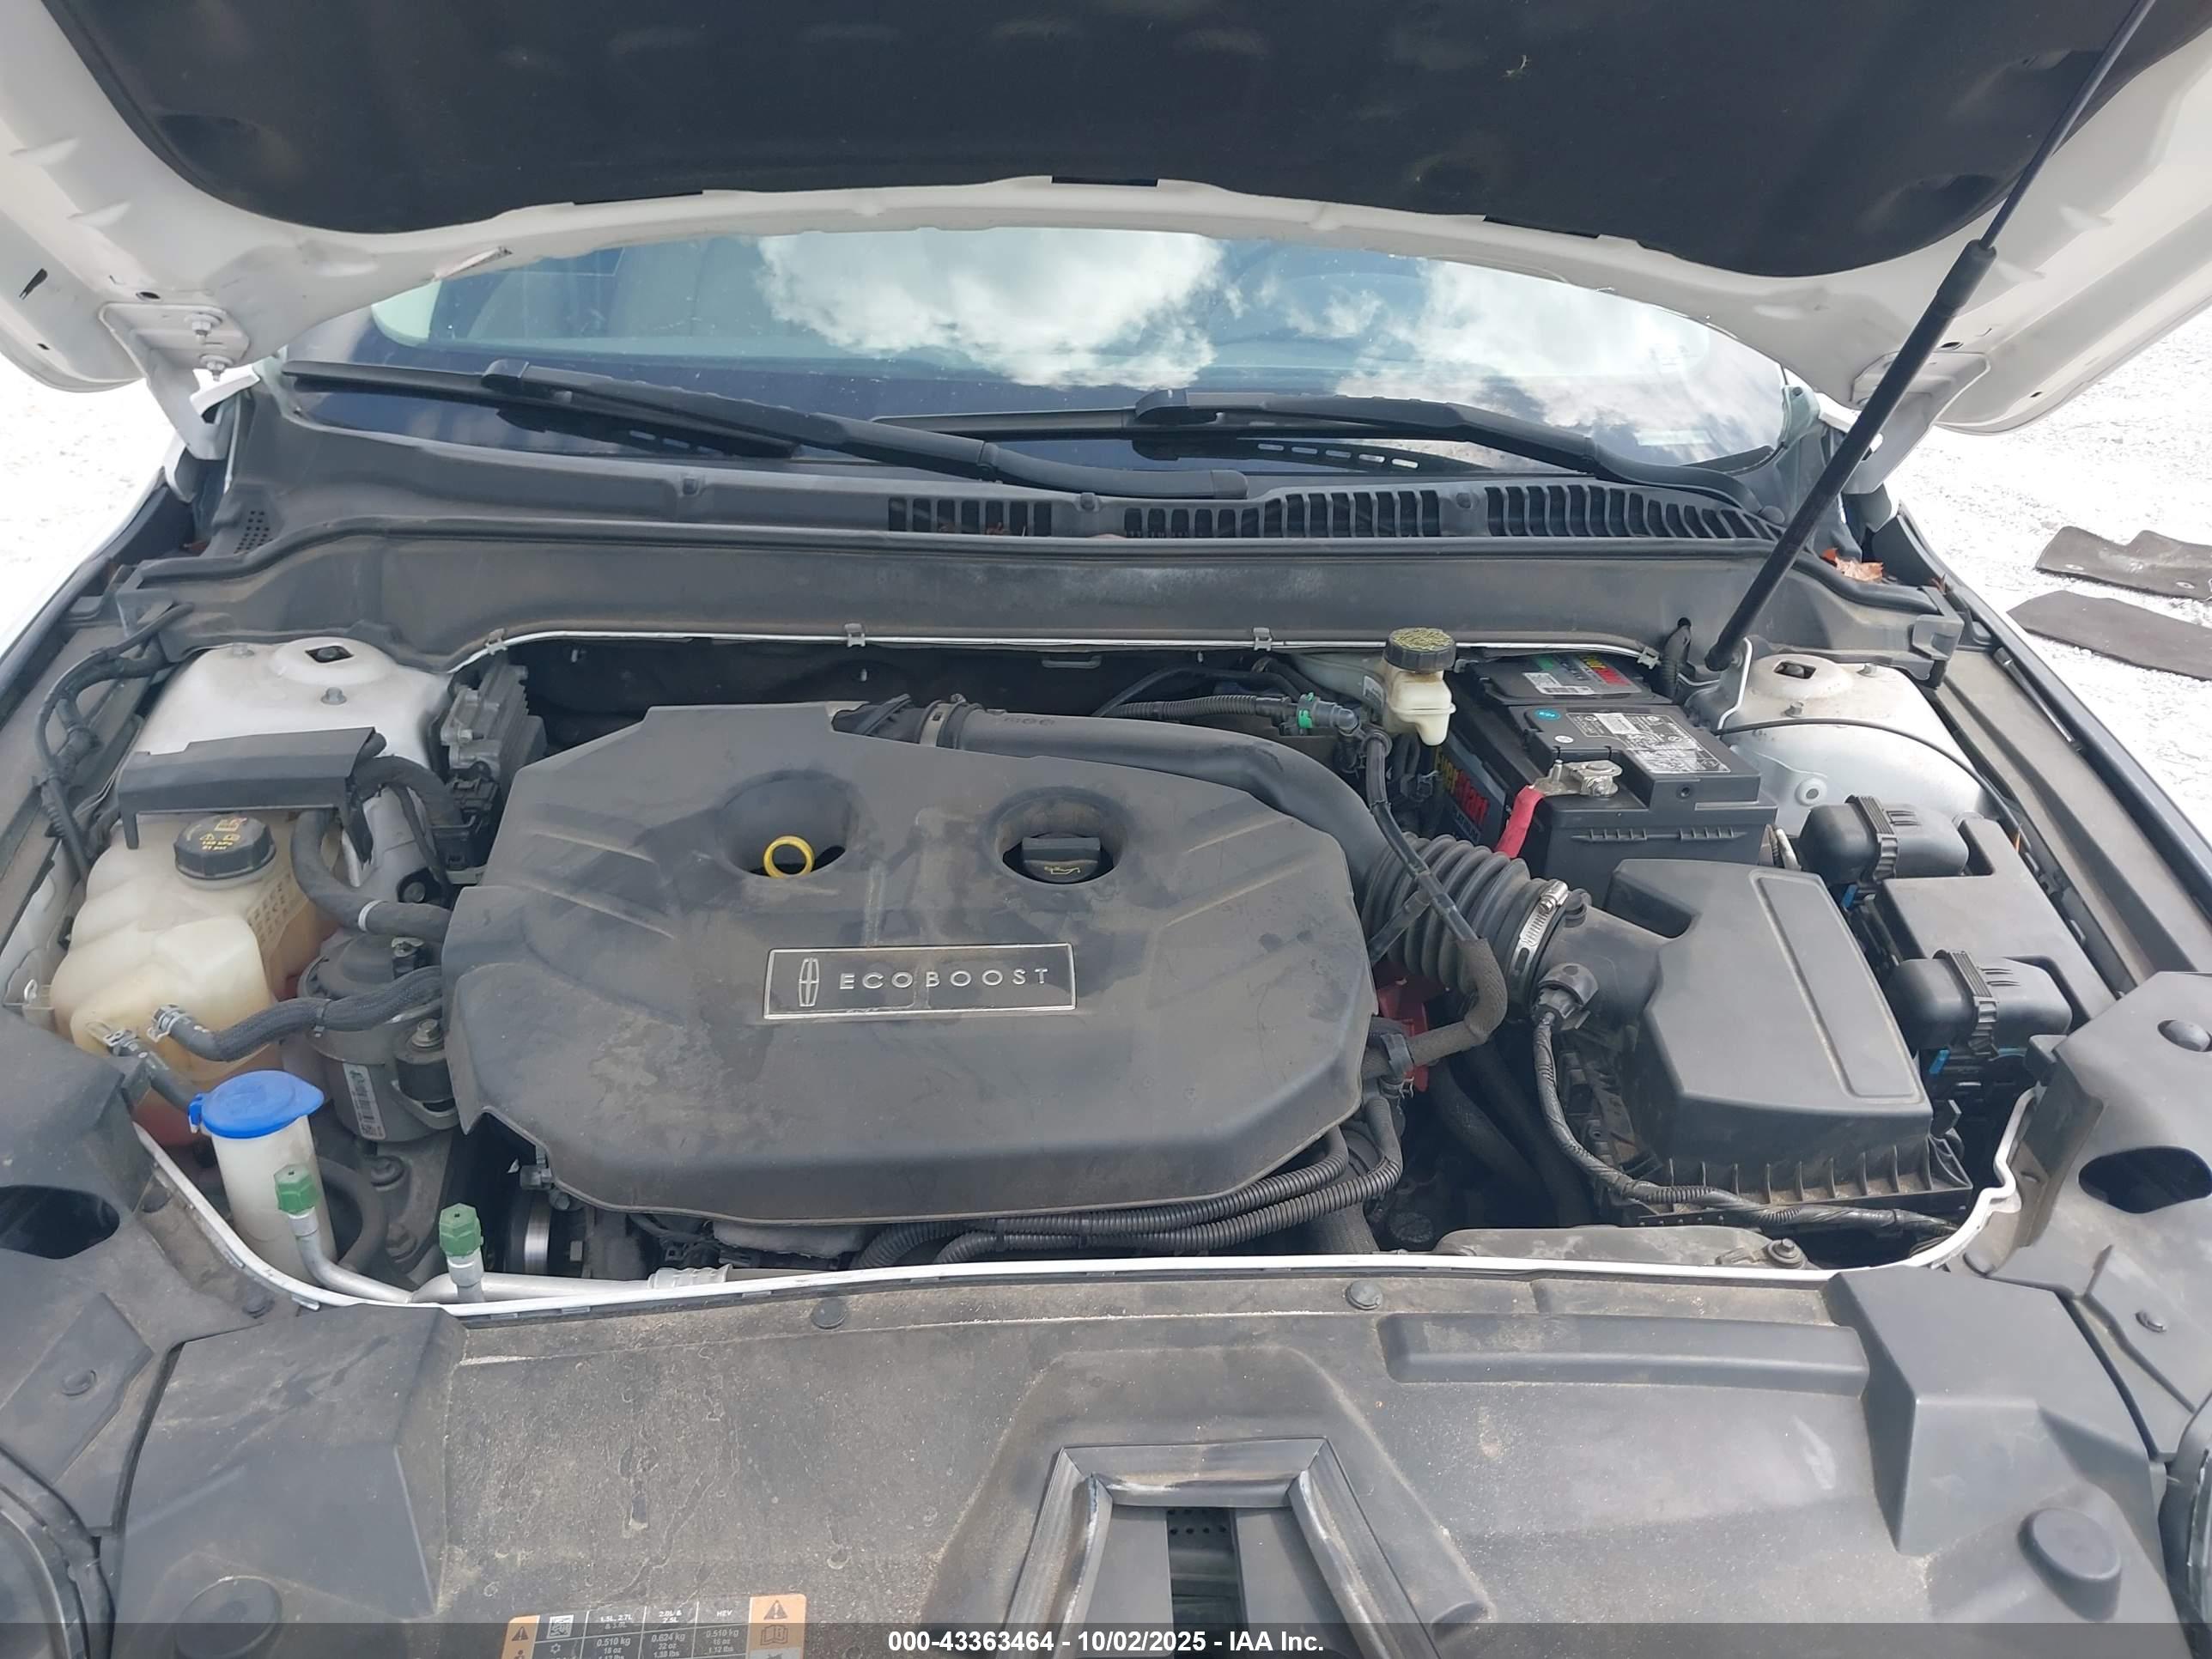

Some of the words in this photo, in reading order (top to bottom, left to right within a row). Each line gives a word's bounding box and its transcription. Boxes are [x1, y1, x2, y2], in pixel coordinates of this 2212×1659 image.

[839, 968, 1048, 989] ECOBOOST
[651, 1633, 673, 1643] 0.624
[675, 1632, 686, 1642] kg
[729, 1629, 739, 1638] kg
[597, 1638, 618, 1647] 0.510
[620, 1637, 631, 1646] kg
